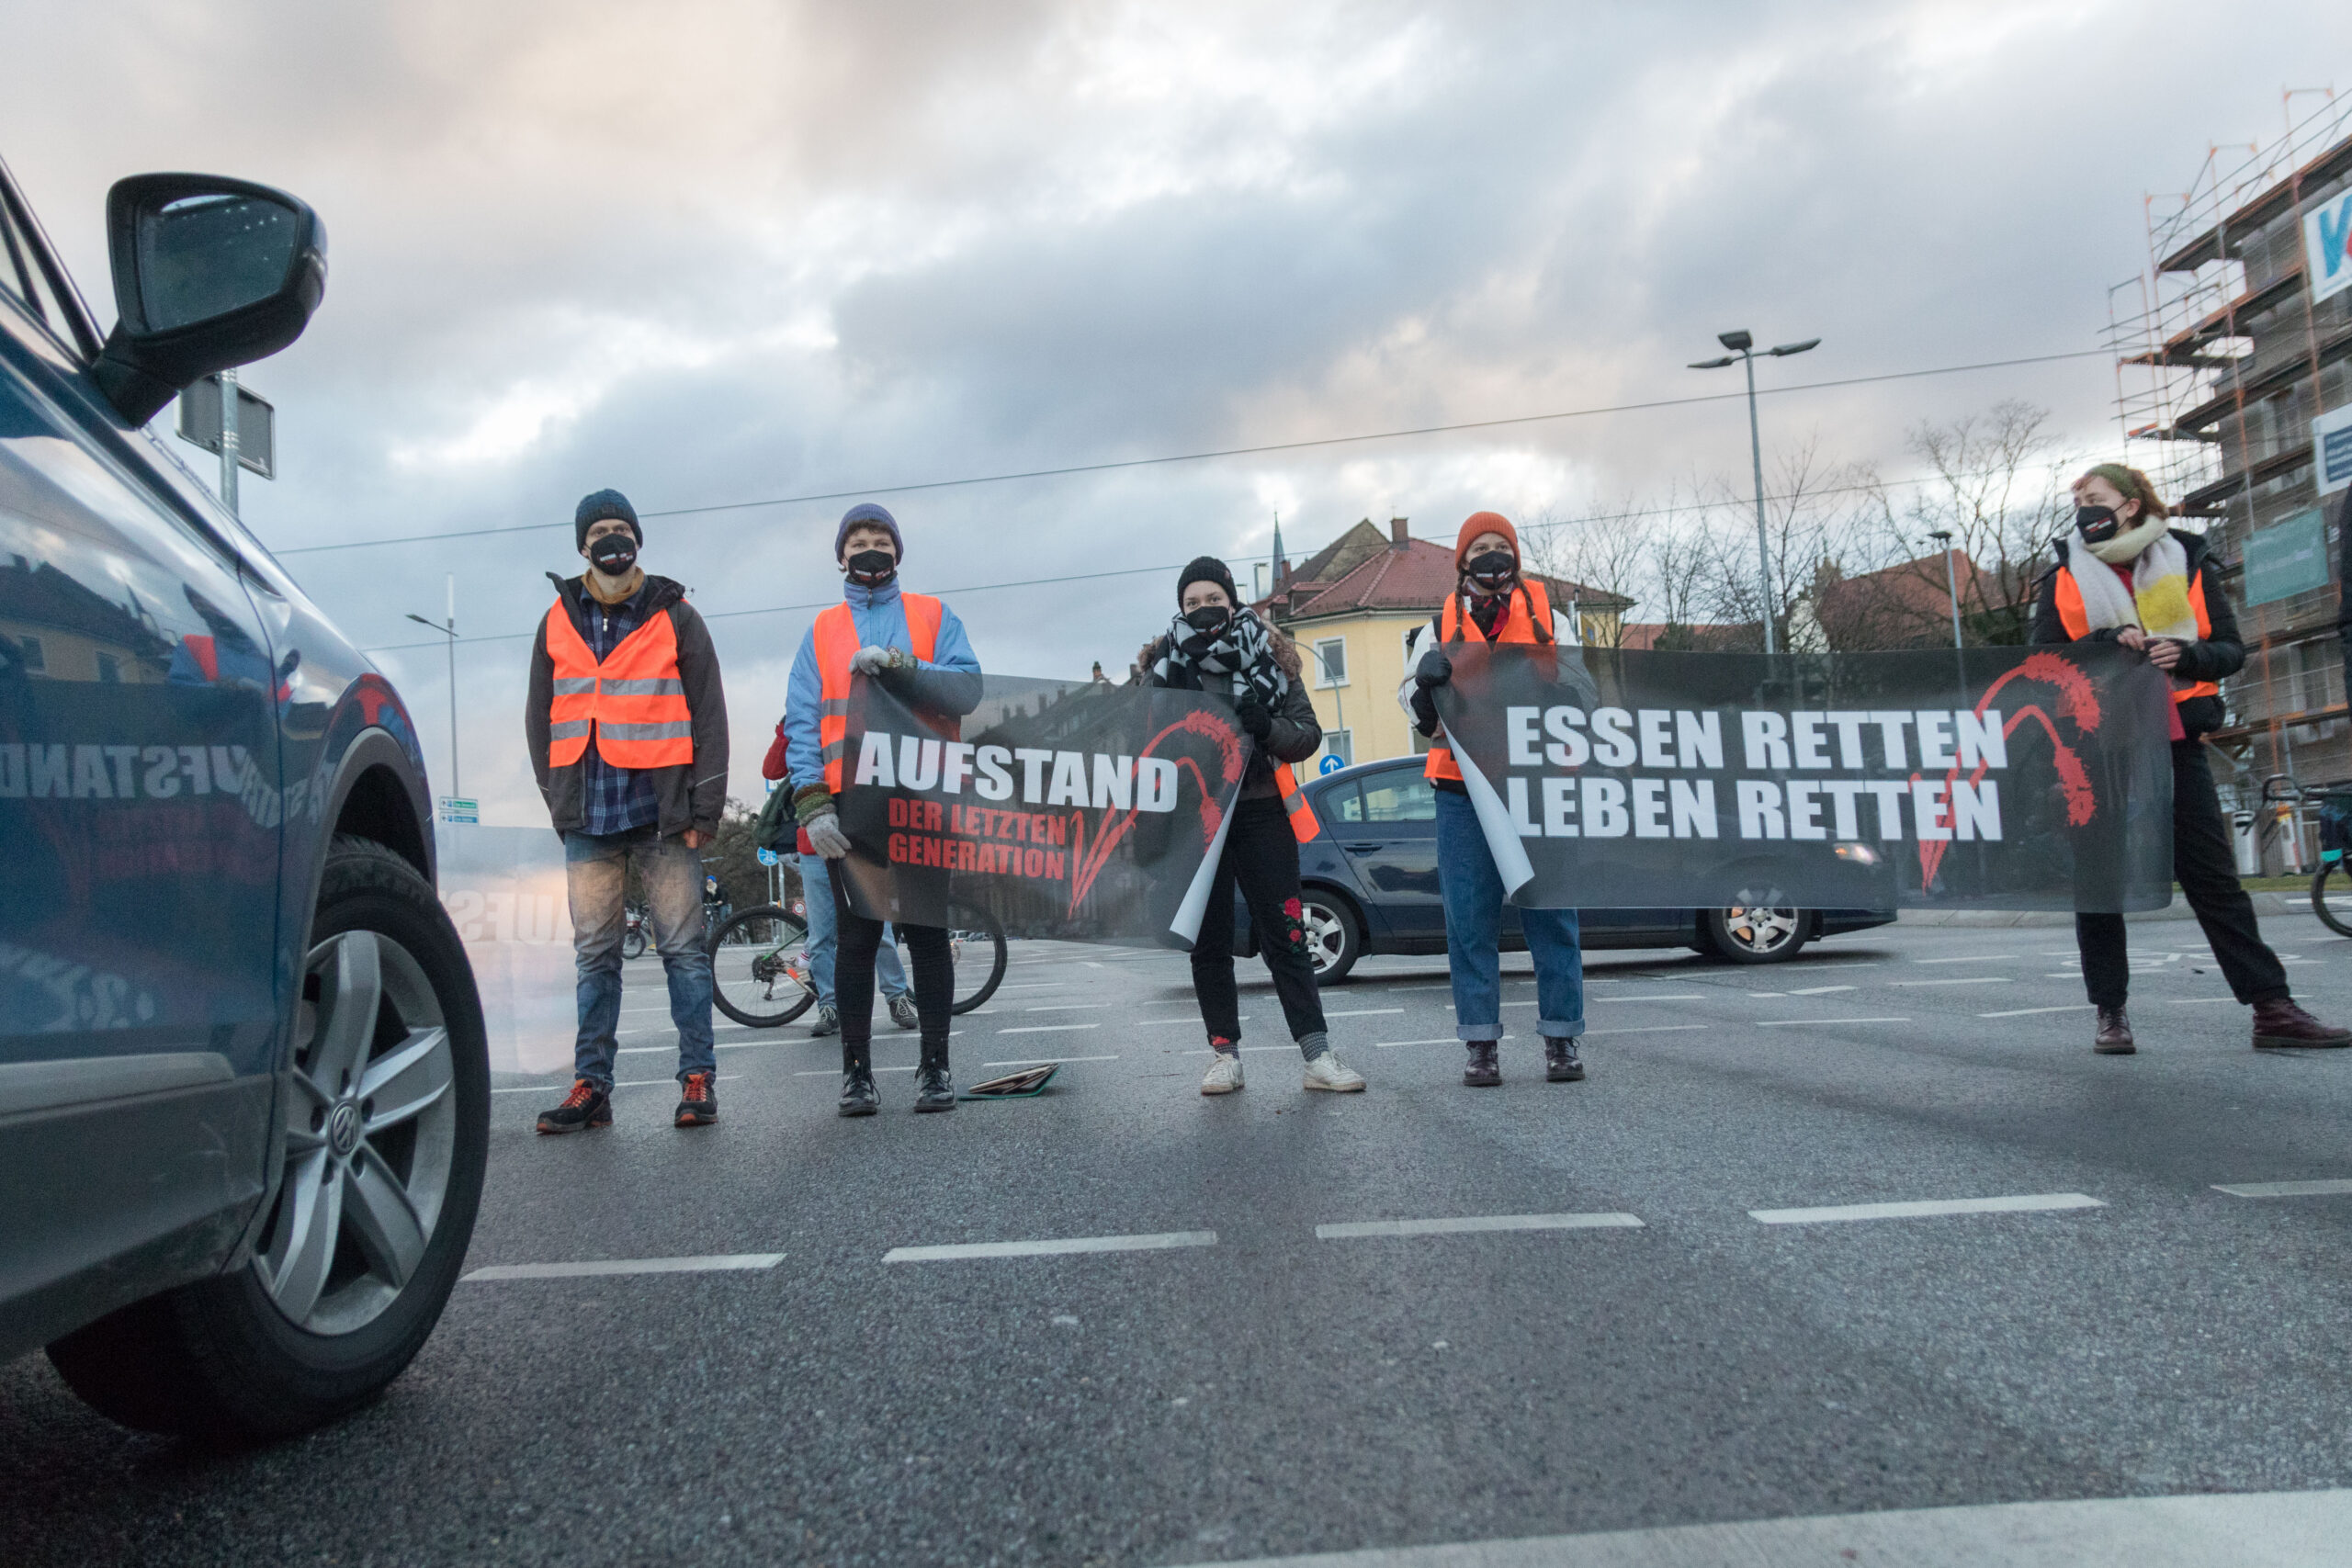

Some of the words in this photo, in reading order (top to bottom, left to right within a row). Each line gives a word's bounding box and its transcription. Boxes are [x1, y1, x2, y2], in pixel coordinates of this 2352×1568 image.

[1506, 705, 1724, 769] ESSEN
[1741, 709, 2008, 770] RETTEN
[854, 730, 1179, 813] AUFSTAND
[888, 797, 943, 831] DER
[950, 802, 1066, 845] LETZTEN
[1506, 776, 1719, 839] LEBEN
[1736, 779, 2003, 840] RETTEN
[888, 832, 1065, 880] GENERATION
